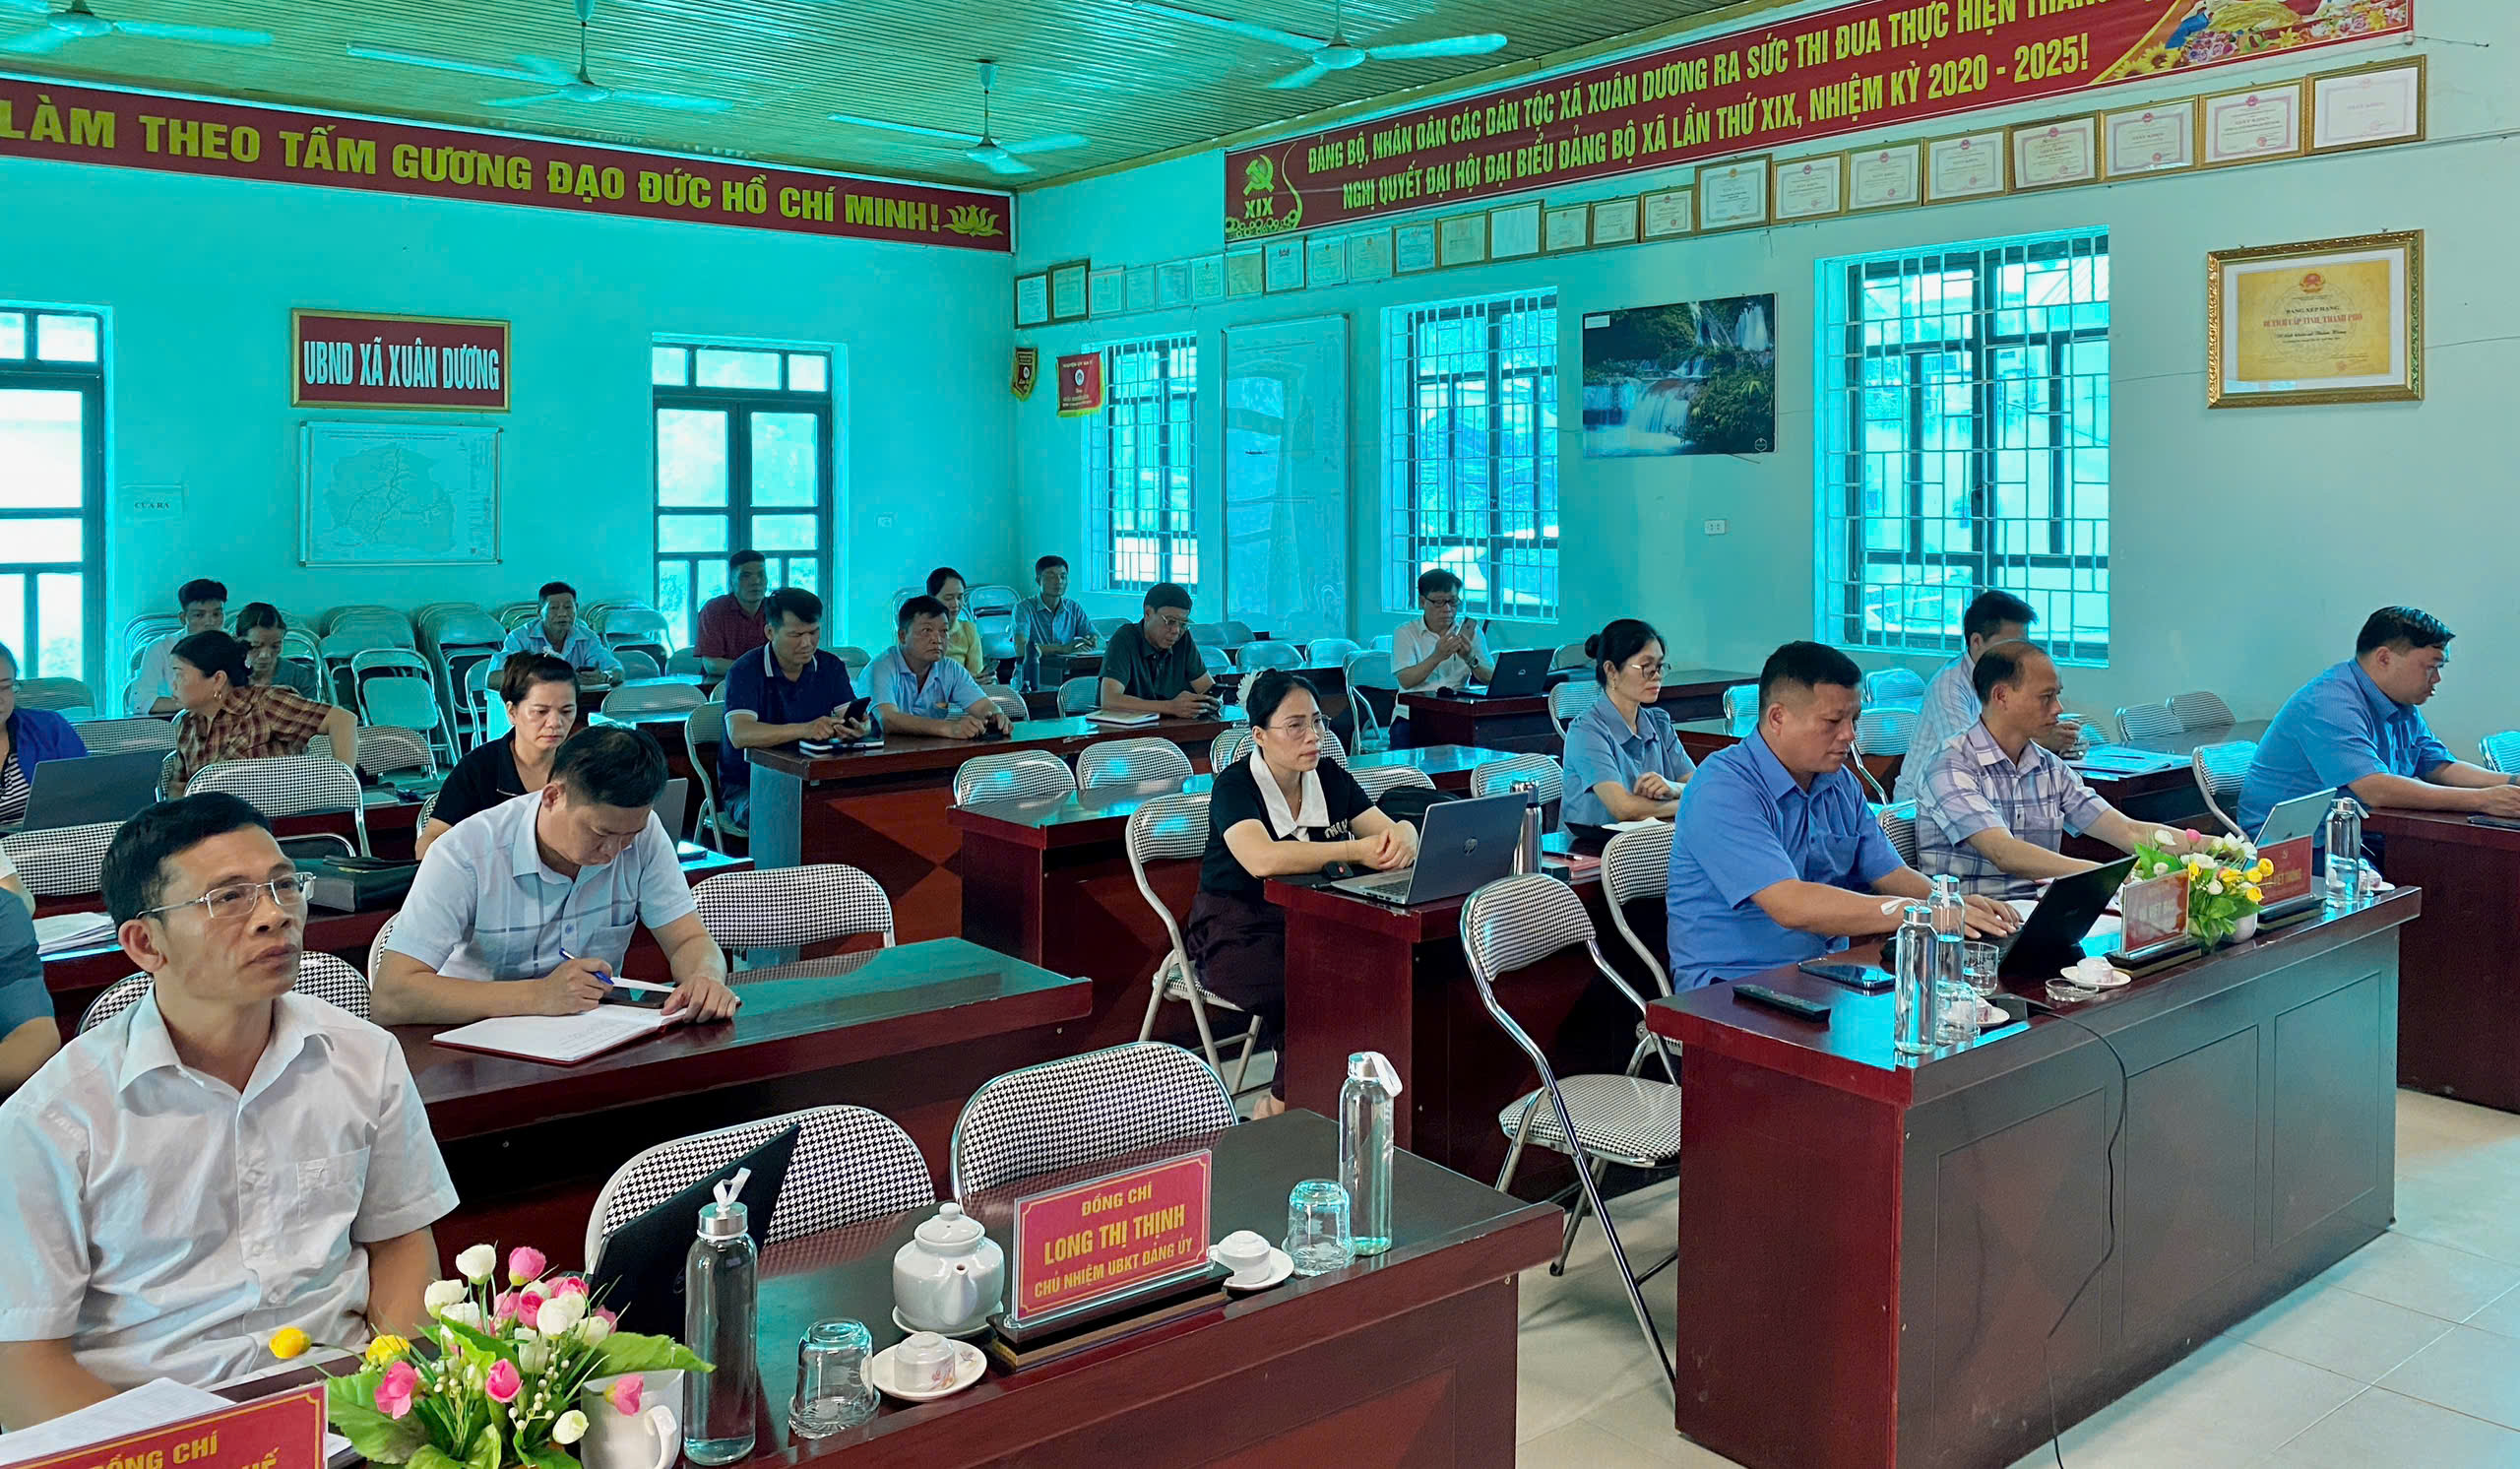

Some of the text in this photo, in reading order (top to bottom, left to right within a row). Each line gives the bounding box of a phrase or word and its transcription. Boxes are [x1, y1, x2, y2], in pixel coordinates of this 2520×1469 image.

[1307, 135, 1344, 174] ĐẢNG
[1347, 133, 1369, 166] BỘ,
[1372, 124, 1413, 160] NHÂN
[1417, 115, 1447, 152] DÂN
[1451, 106, 1481, 143] CÁC
[1485, 99, 1518, 134] DÂN
[1523, 91, 1554, 130] TỘC
[1559, 81, 1583, 119] XÃ
[1587, 70, 1637, 114] XUÂN
[1642, 58, 1707, 102] DƯƠNG
[1713, 50, 1740, 88] RA
[1747, 32, 1788, 80] SỨC
[1796, 29, 1828, 69] THI
[1835, 18, 1881, 61] ĐUA
[1888, 0, 1949, 49] THỰC
[1343, 178, 1376, 211] NGHỊ
[1379, 160, 1422, 205] QUYẾT
[1425, 164, 1451, 198] ĐẠI
[1455, 153, 1481, 193] HỘI
[1484, 155, 1512, 188] ĐẠI
[1516, 132, 1553, 177] BIỂU
[1558, 125, 1606, 170] ĐẢNG
[1611, 122, 1636, 164] BỘ
[1641, 113, 1668, 155] XÃ
[1671, 102, 1711, 149] LẦN
[1716, 96, 1757, 140] THỨ
[1760, 93, 1803, 132] XIX,
[1809, 72, 1883, 122] NHIỆM
[1891, 60, 1922, 107] KỲ
[1927, 54, 1988, 100] 2020
[2014, 32, 2089, 84] 2025!
[0, 94, 939, 232] LÀM THEO TẤM GƯƠNG ĐẠO ĐỨC HỒ CHÍ MINH!
[1243, 197, 1273, 220] XIX
[303, 336, 499, 390] UBND XÃ XUÂN DƯƠNG
[1128, 1182, 1152, 1204] CHÍ
[1044, 1204, 1185, 1265] LONG THỊ THỊNH
[1035, 1234, 1193, 1299] CHỦ NHIỆM UBKT ĐẢNG ỦY
[172, 1430, 219, 1465] CHÍ
